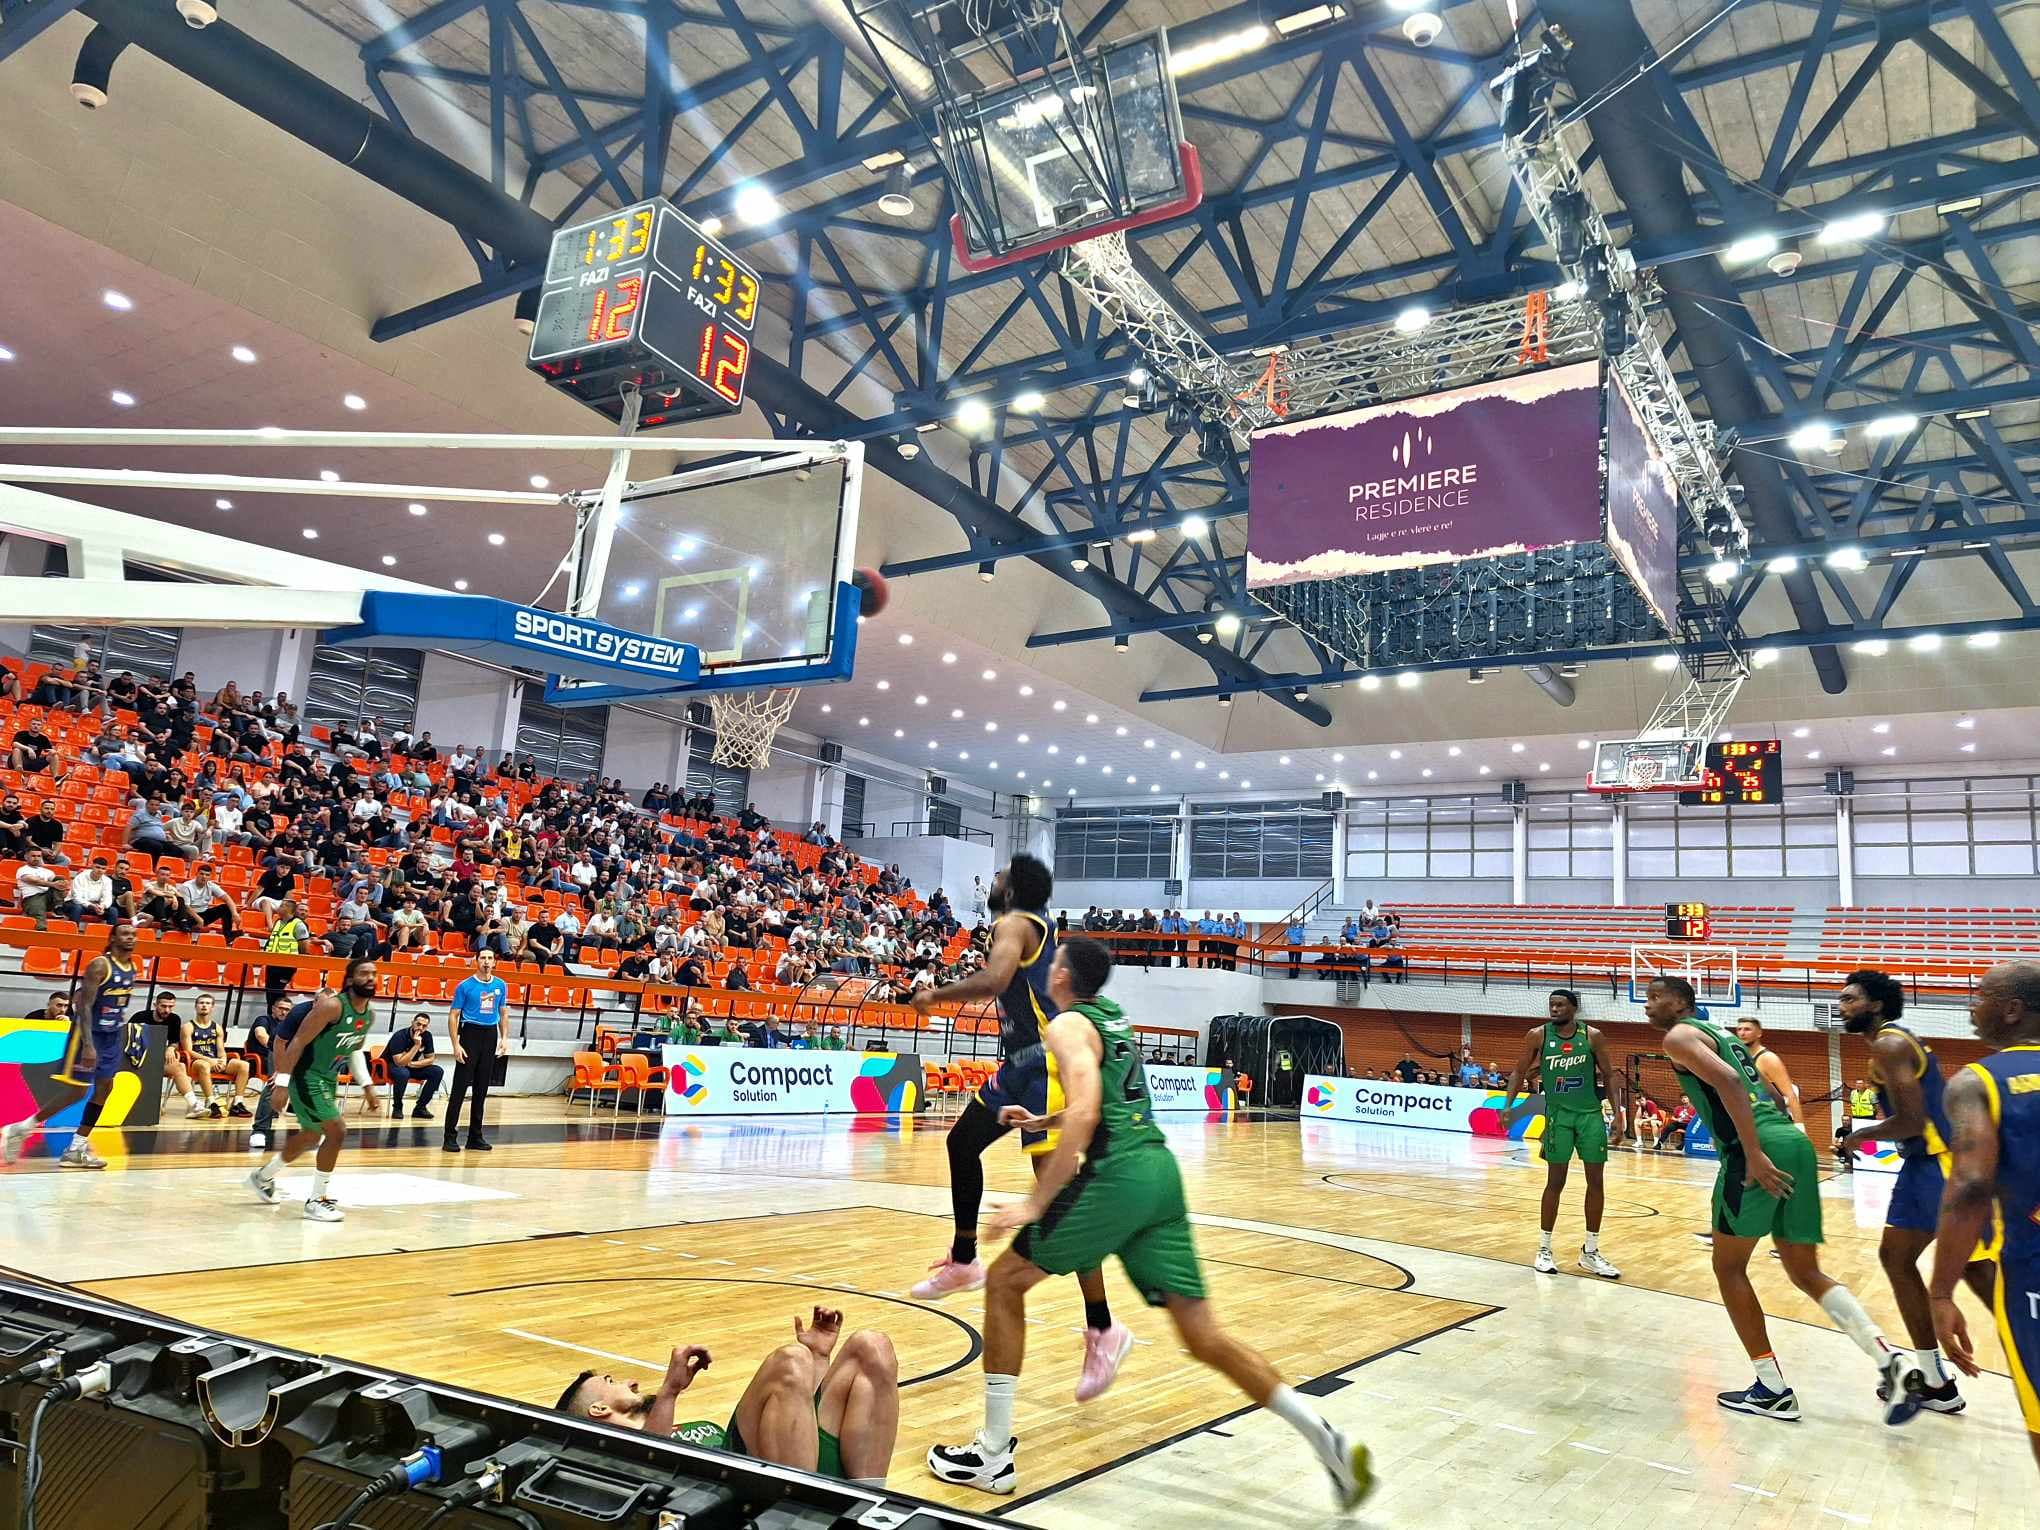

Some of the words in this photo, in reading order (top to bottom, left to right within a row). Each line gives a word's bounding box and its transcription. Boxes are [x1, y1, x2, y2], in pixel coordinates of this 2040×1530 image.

[584, 211, 652, 265] 1:33
[579, 267, 609, 287] FAZI
[692, 244, 757, 321] 1:33
[588, 277, 642, 342] 12
[687, 286, 716, 318] FAZI
[699, 326, 748, 402] 12
[1348, 464, 1477, 503] PREMIERE
[1355, 489, 1469, 521] RESIDENCE
[730, 1062, 833, 1093] Compact
[1151, 1074, 1196, 1096] Compact
[733, 1089, 777, 1102] Solution
[1154, 1093, 1175, 1102] Solution
[1355, 1088, 1453, 1112] Compact
[1355, 1105, 1395, 1117] Solution
